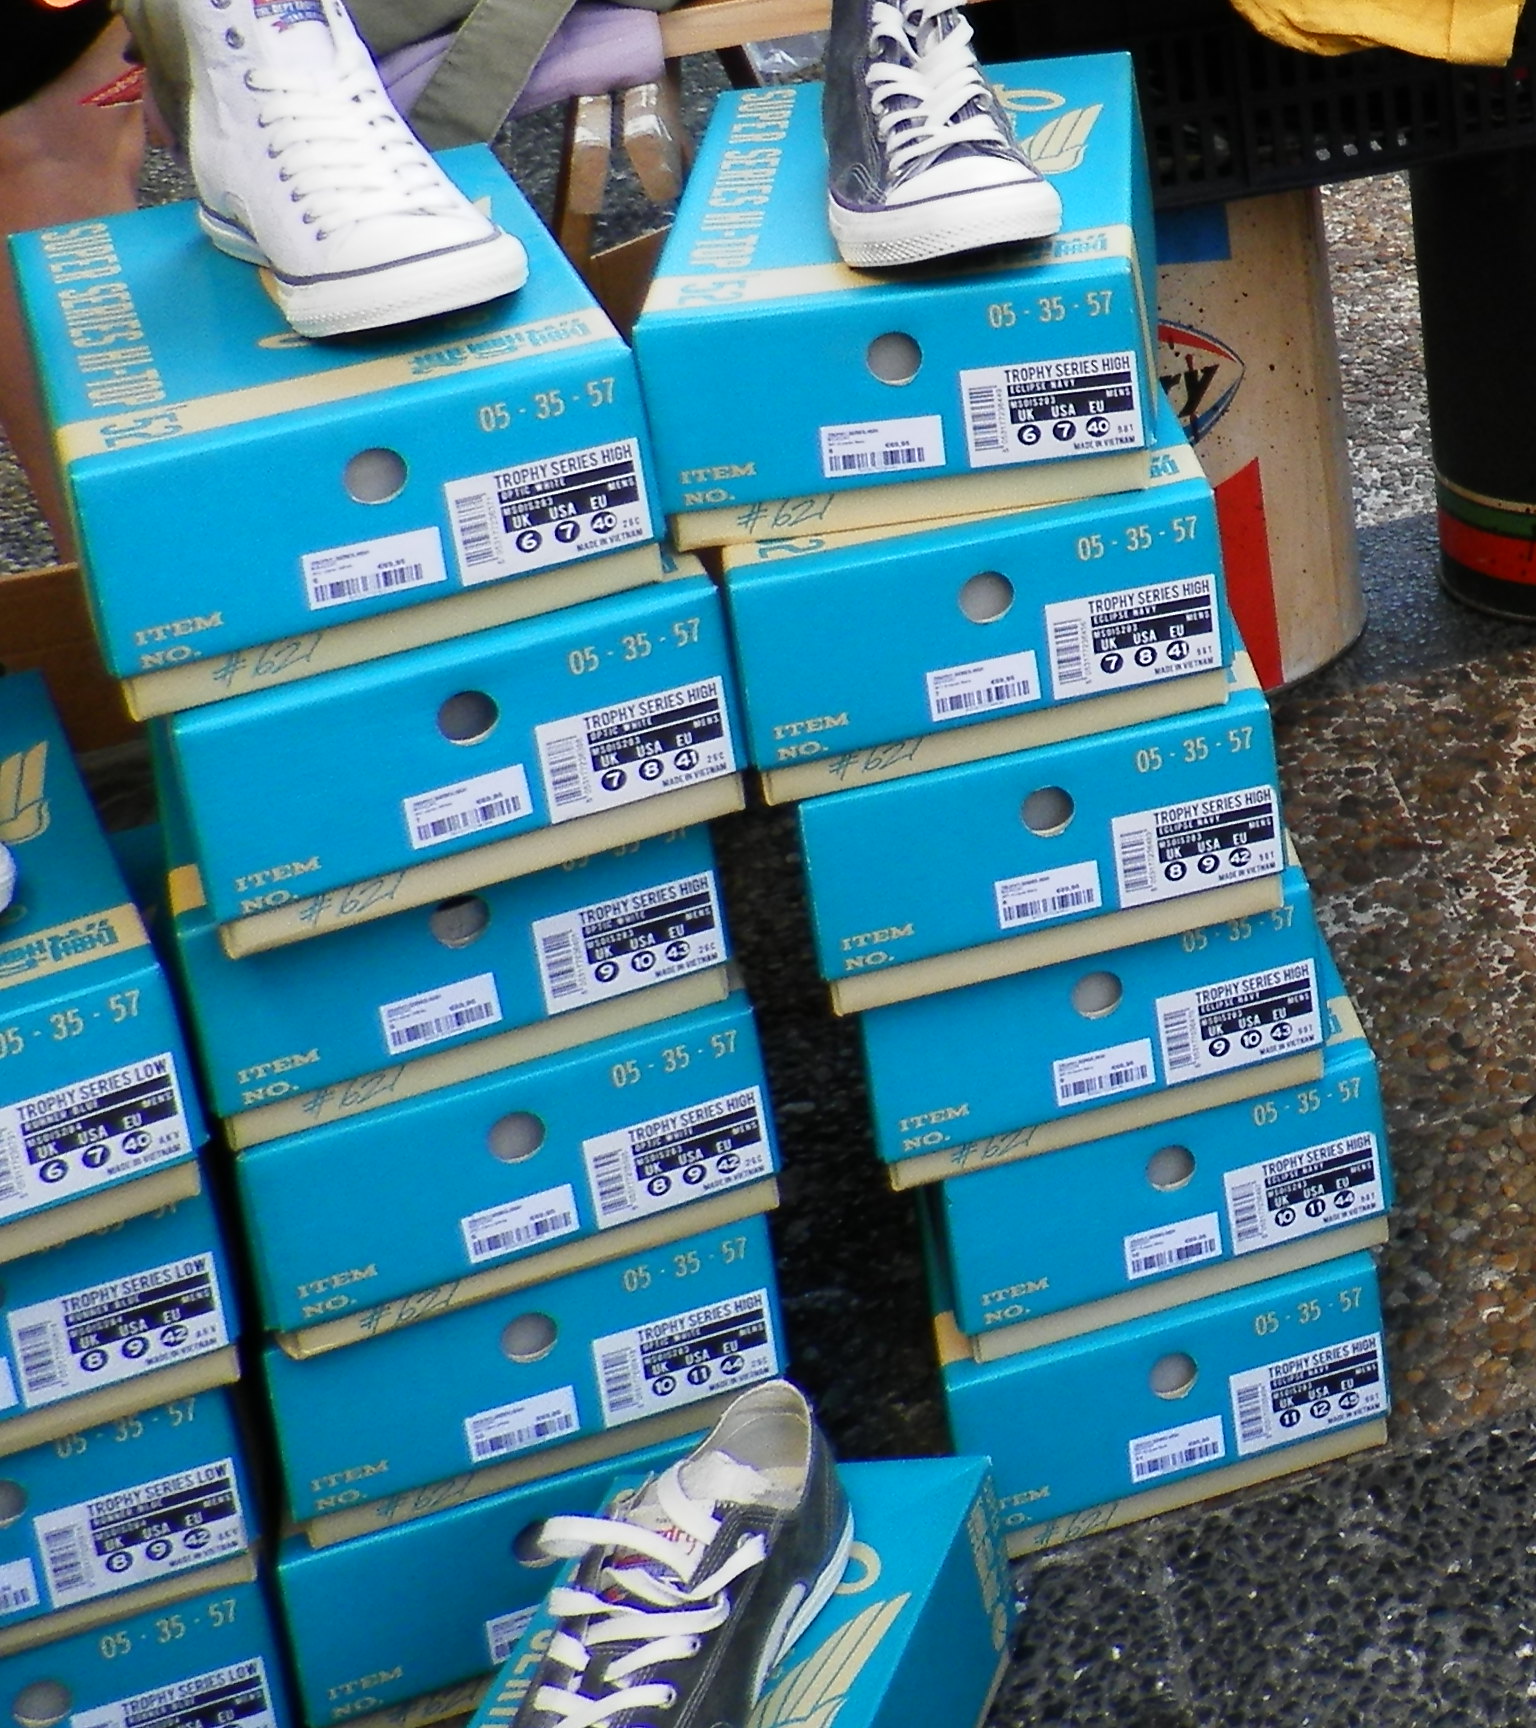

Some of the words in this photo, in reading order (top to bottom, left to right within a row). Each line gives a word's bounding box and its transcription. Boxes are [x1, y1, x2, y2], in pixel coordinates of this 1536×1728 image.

[58, 282, 144, 349] SERIES
[1004, 365, 1053, 383] TROPHY
[1058, 360, 1098, 377] SERIES
[1102, 356, 1130, 372] HIGH
[1018, 408, 1035, 422] UK
[1051, 403, 1075, 418] USA
[1088, 399, 1105, 413] EU
[494, 464, 548, 490] TROPHY
[552, 452, 598, 476] SERIES
[601, 444, 632, 464] HIGH
[680, 462, 757, 484] ITEM
[512, 512, 531, 530] UK
[548, 501, 576, 520] USA
[589, 493, 608, 510] EU
[1088, 592, 1134, 613] TROPHY
[1138, 584, 1178, 604] SERIES
[1182, 579, 1209, 596] HIGH
[134, 611, 224, 646] ITEM
[1101, 636, 1117, 651] UK
[1132, 629, 1156, 645] USA
[1169, 624, 1185, 638] EU
[584, 705, 634, 731] TROPHY
[638, 691, 682, 716] SERIES
[685, 682, 716, 703] HIGH
[1153, 804, 1198, 825] TROPHY
[1202, 795, 1241, 815] SERIES
[1244, 788, 1271, 805] HIGH
[579, 899, 628, 925] TROPHY
[633, 885, 675, 909] SERIES
[678, 876, 708, 896] HIGH
[1195, 982, 1239, 1004] TROPHY
[1243, 971, 1280, 992] SERIES
[1283, 964, 1308, 981] HIGH
[16, 1088, 77, 1121] TROPHY
[78, 1071, 132, 1100] SERIES
[134, 1059, 168, 1080] LOW
[628, 1116, 676, 1143] TROPHY
[680, 1102, 722, 1126] SERIES
[725, 1092, 755, 1112] HIGH
[1263, 1154, 1305, 1176] TROPHY
[1309, 1143, 1344, 1163] SERIES
[1347, 1136, 1371, 1152] HIGH
[637, 1317, 685, 1342] TROPHY
[689, 1303, 730, 1327] SERIES
[733, 1294, 762, 1313] HIGH
[1268, 1356, 1309, 1378] TROPHY
[1313, 1345, 1348, 1365] SERIES
[1351, 1337, 1375, 1354] HIGH
